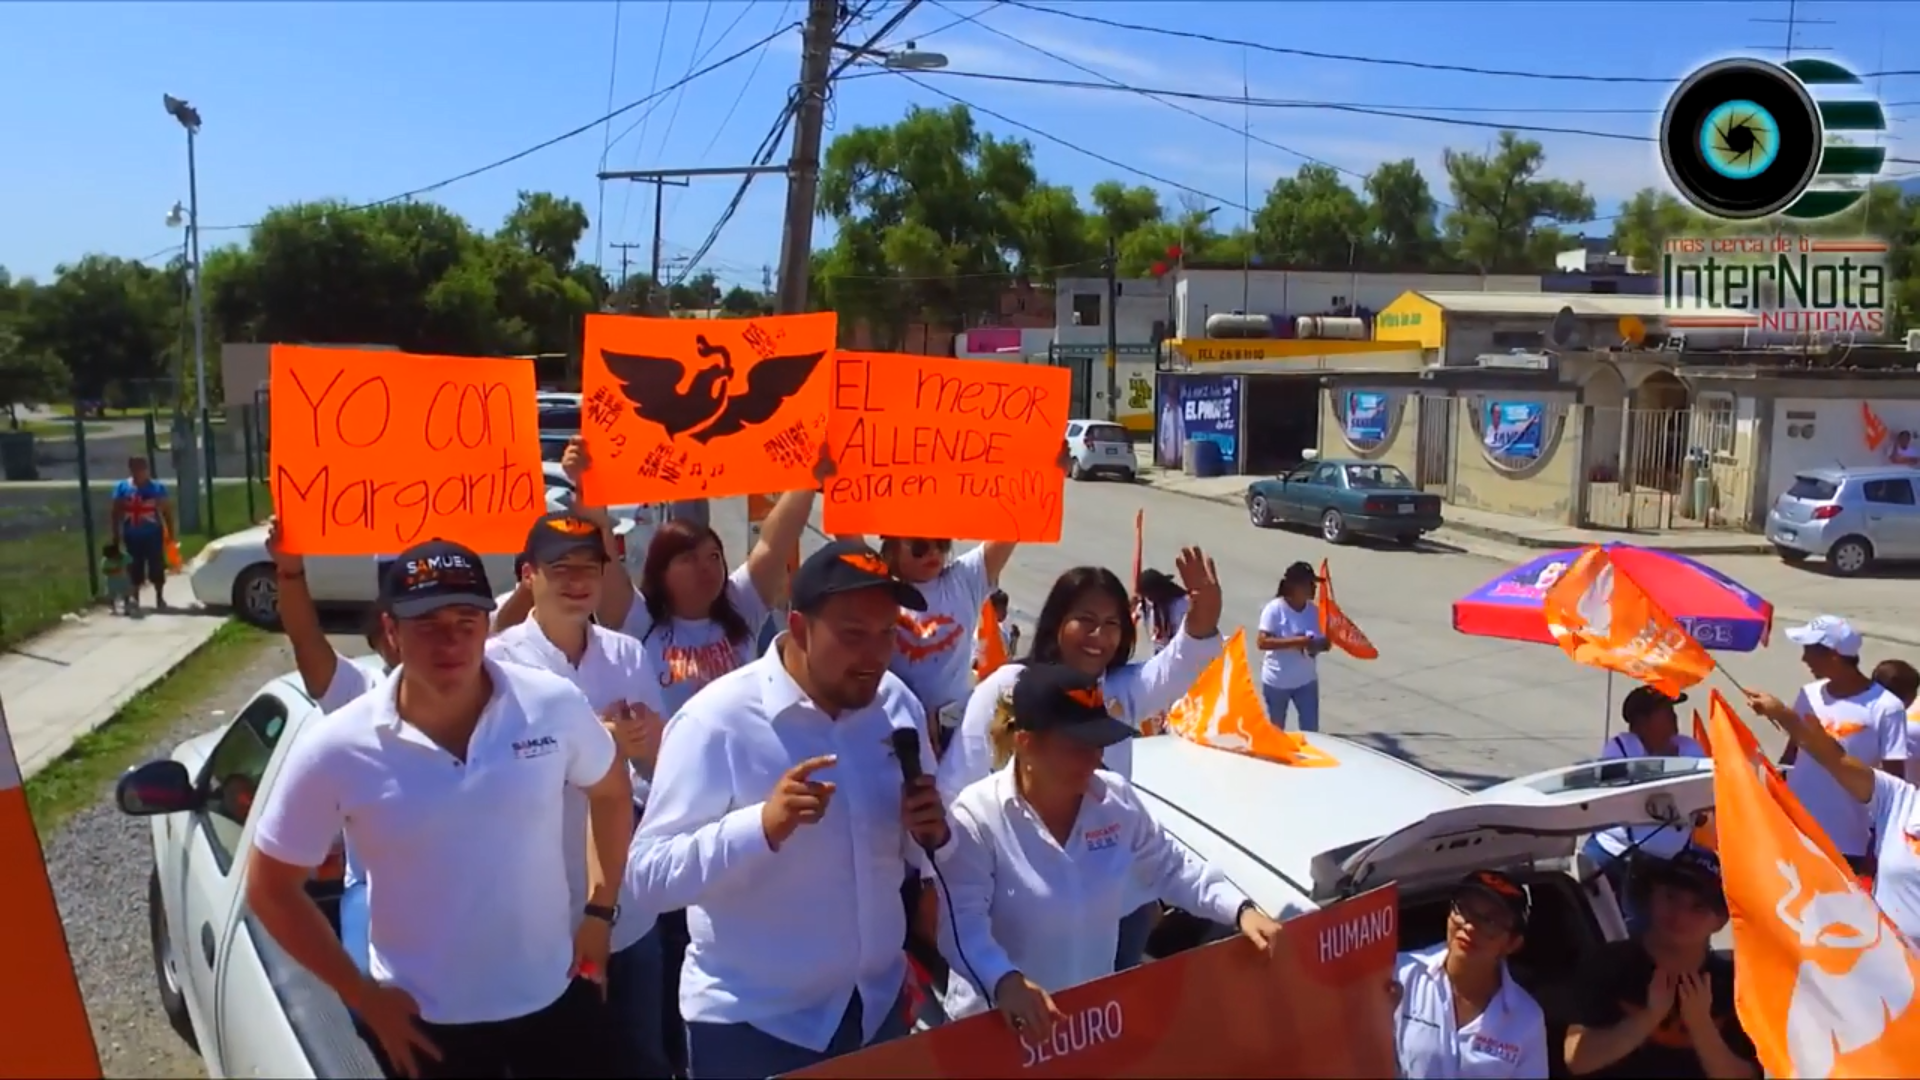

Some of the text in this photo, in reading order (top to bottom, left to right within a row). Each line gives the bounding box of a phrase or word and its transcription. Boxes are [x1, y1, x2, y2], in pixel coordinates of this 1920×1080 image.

[835, 359, 885, 413] EL
[425, 378, 516, 452] con
[838, 416, 1012, 468] ALLENDE
[276, 447, 537, 544] Margarita
[901, 474, 937, 497] en
[406, 555, 472, 575] SAMUEL
[1319, 904, 1394, 964] HUMANO
